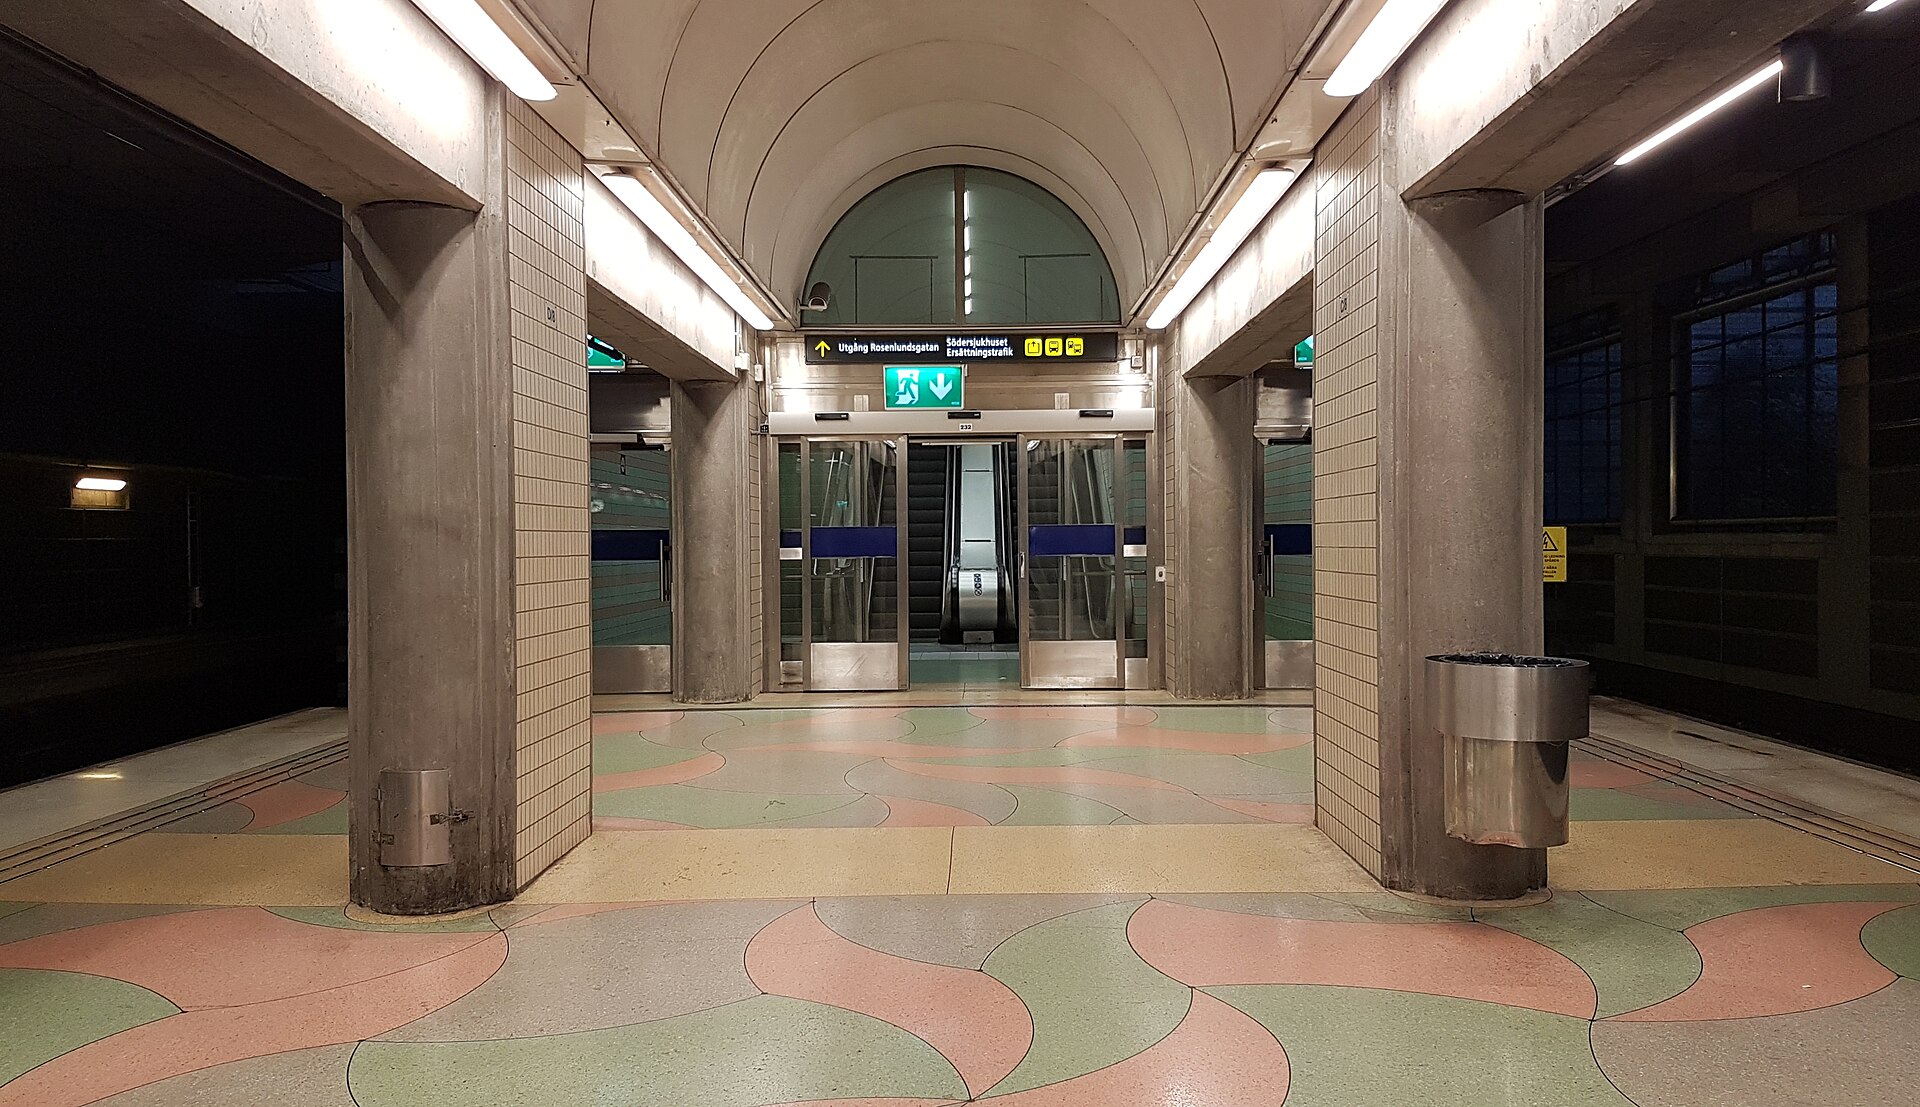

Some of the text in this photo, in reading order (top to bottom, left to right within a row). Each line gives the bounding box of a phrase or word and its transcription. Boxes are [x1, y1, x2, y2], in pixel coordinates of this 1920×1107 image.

[838, 342, 940, 354] Utgång Rosenlundsgatan
[946, 337, 1008, 348] Södersjukhuset
[946, 347, 1014, 359] Ersättningstrafik
